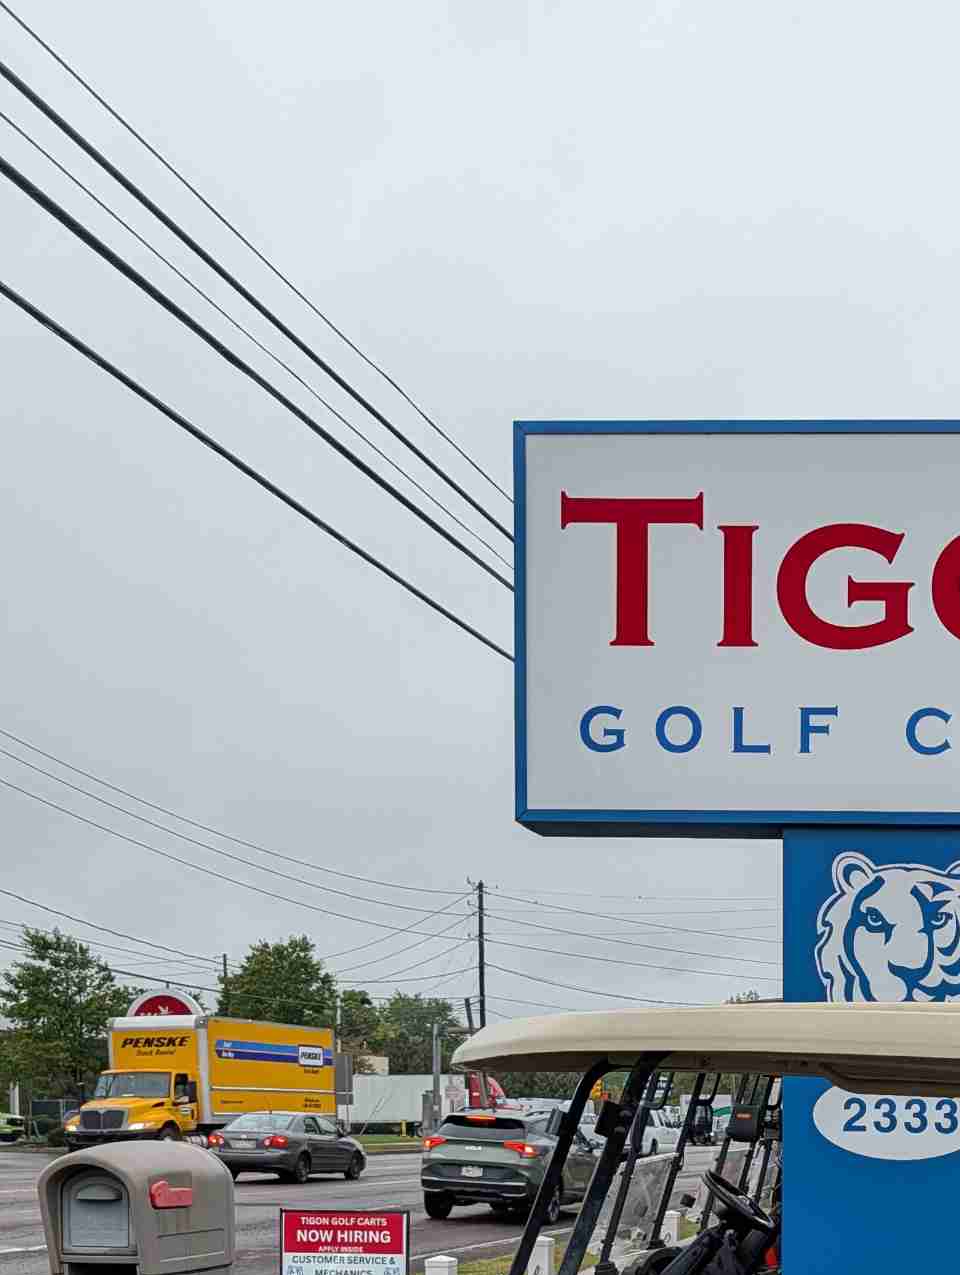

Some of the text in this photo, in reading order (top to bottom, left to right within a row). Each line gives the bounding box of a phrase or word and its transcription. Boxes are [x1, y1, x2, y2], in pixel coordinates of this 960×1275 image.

[579, 705, 838, 754] GOLF
[121, 1036, 191, 1048] PENSKE
[843, 1097, 959, 1134] 2333
[300, 1217, 387, 1226] TIGON GOLF CARTS
[296, 1229, 391, 1244] NOW HIRING
[292, 1255, 396, 1265] CUSTOMER SERVICE &
